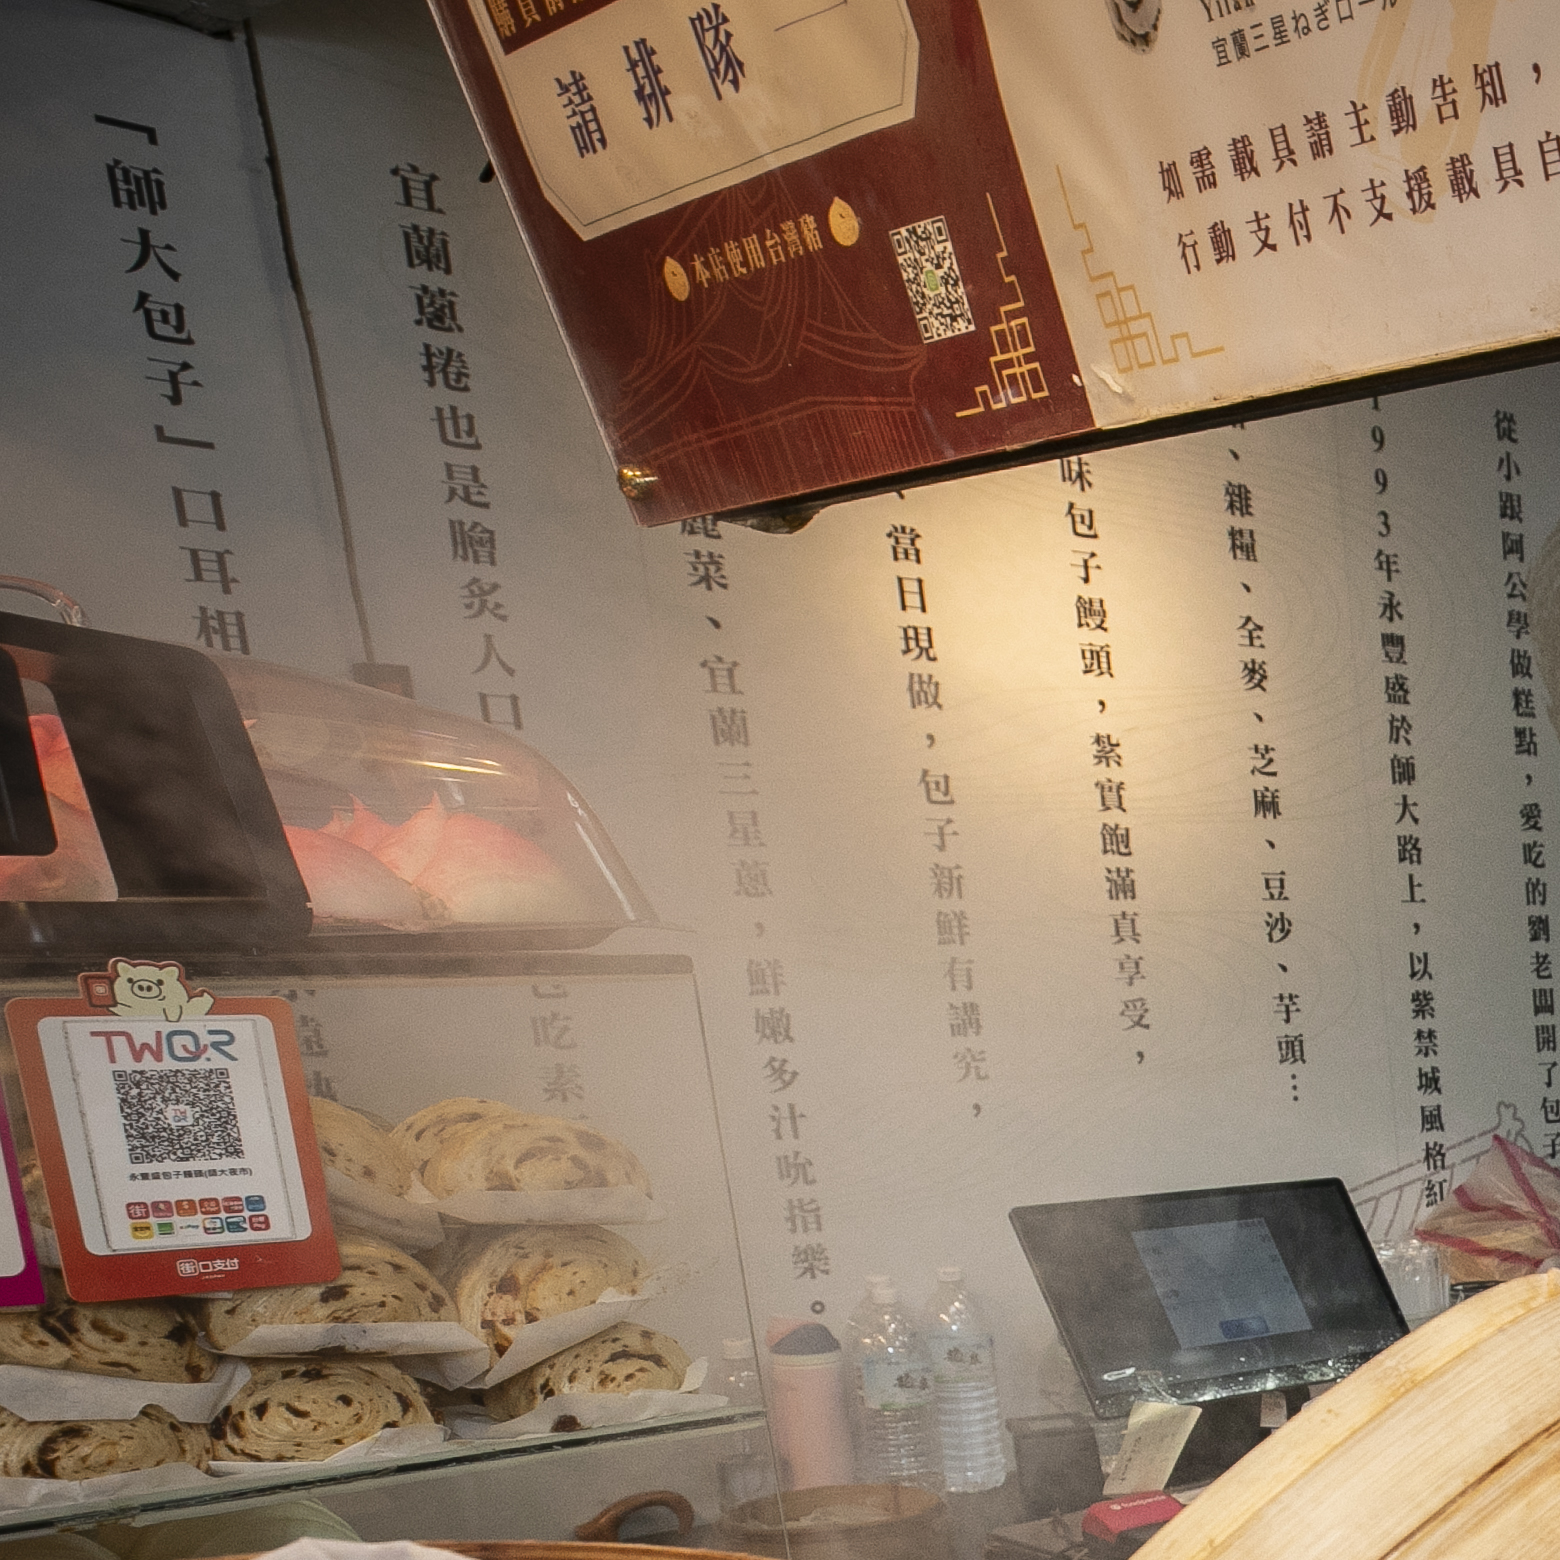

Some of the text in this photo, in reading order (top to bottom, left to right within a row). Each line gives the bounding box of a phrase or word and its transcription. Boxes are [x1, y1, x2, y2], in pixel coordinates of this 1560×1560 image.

[554, 2, 746, 159] 請排隊
[1158, 60, 1542, 205] 如需載具請主動告知，
[690, 213, 824, 288] 本店使用台灣豬
[94, 113, 251, 656] 「師大包子」口耳相
[1222, 421, 1307, 1102] 、雜糧、全麥、芝麻、豆沙、芋頭…
[89, 1029, 240, 1064] TWQR
[176, 1257, 240, 1277] 街口支付
